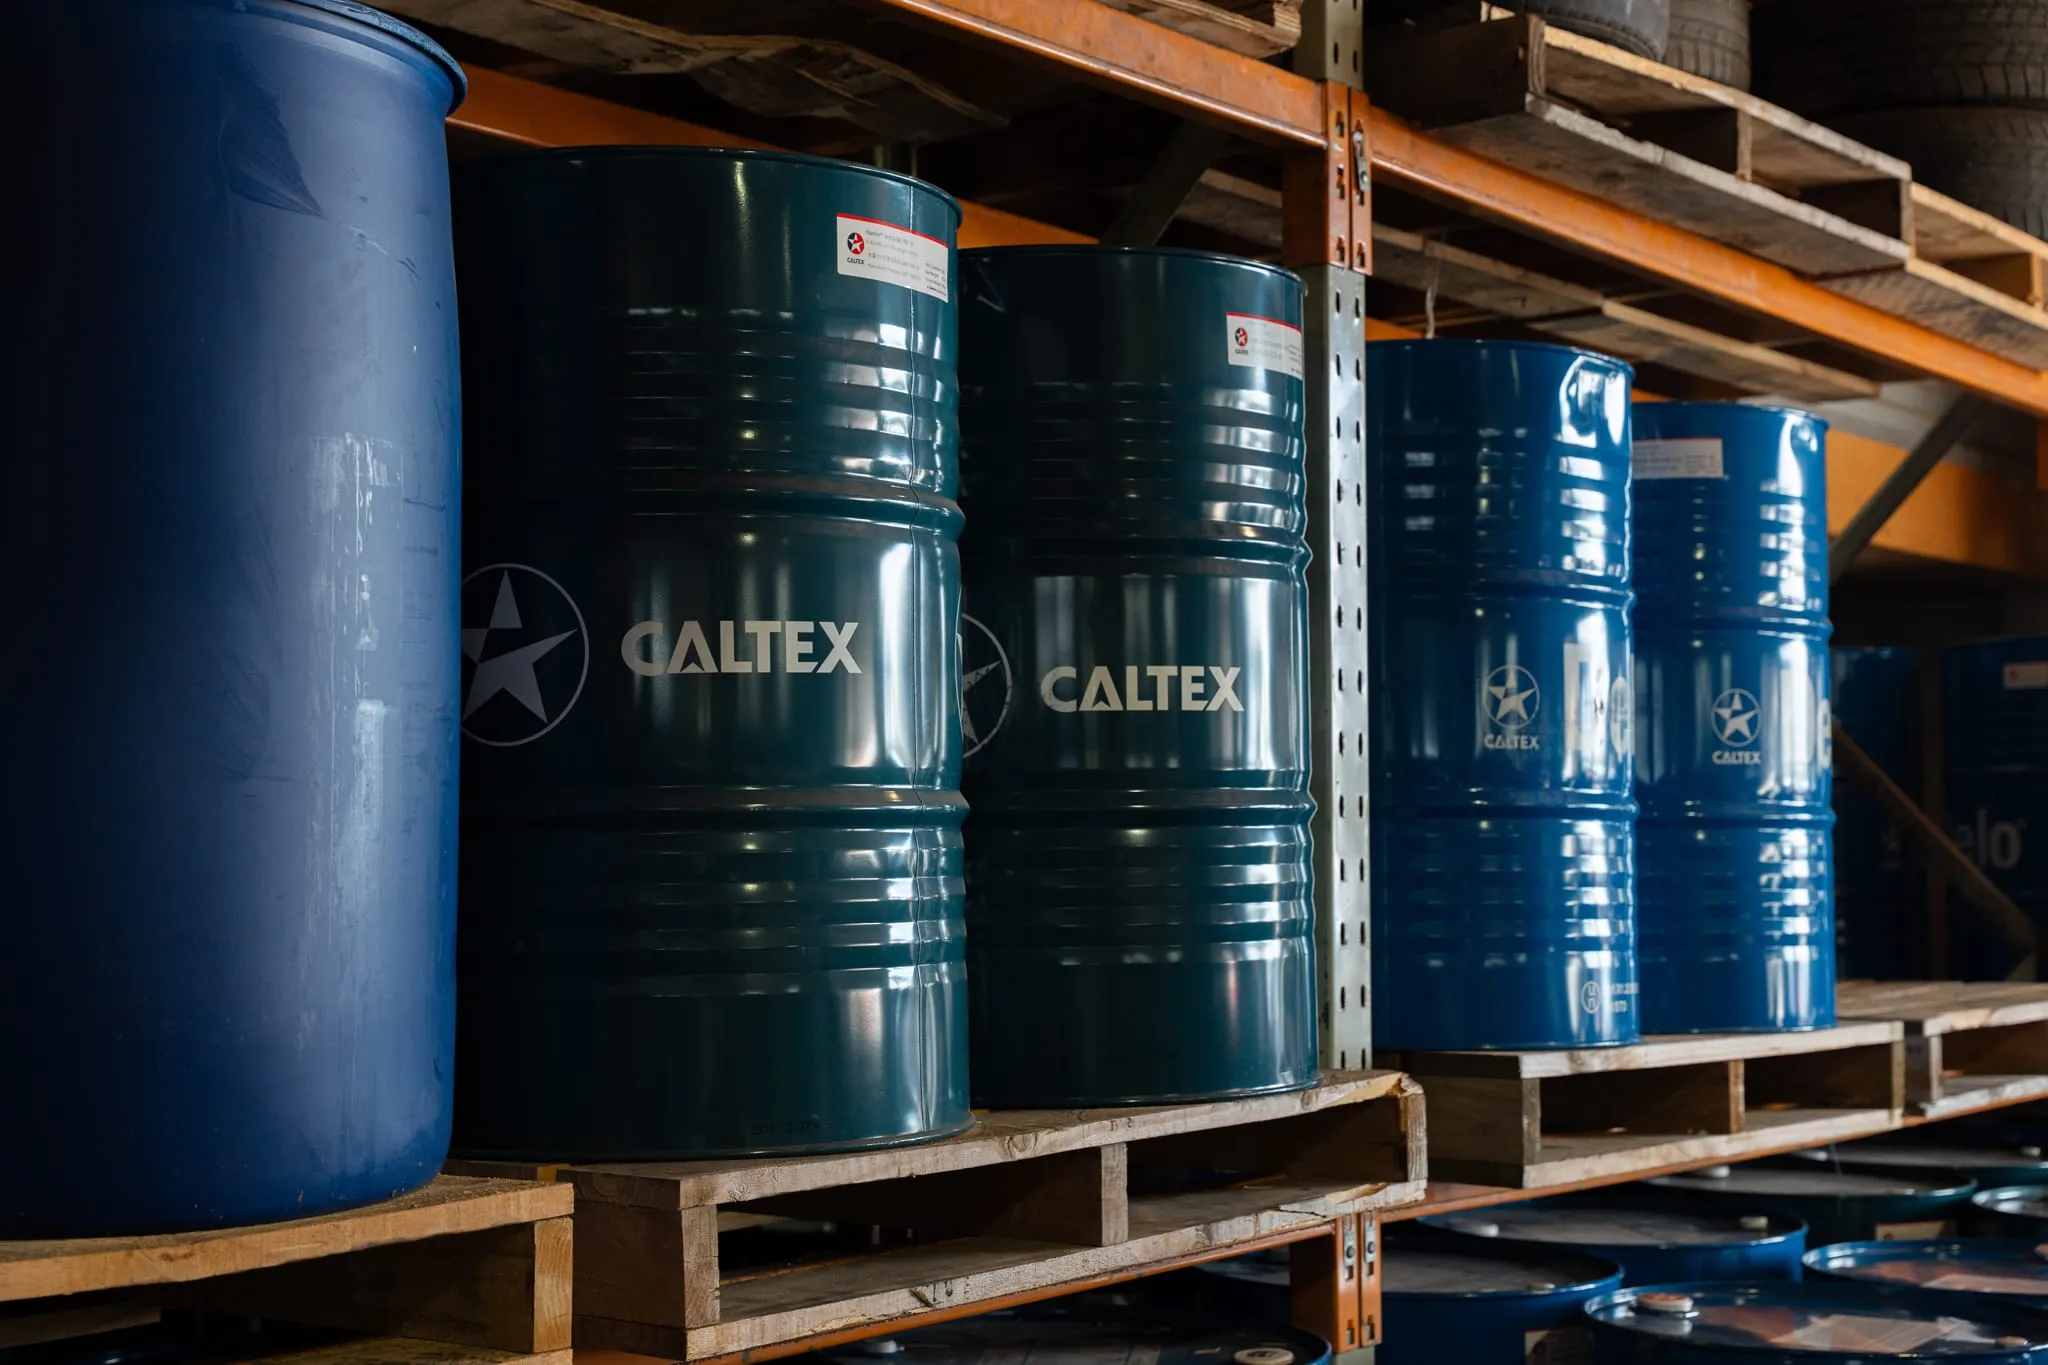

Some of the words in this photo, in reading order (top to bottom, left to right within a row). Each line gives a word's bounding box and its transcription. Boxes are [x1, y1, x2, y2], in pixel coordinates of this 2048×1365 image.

[621, 619, 863, 677] CALTEX
[1040, 665, 1244, 713] CALTEX
[1483, 733, 1540, 752] CALTEX
[1711, 750, 1761, 765] CALTEX
